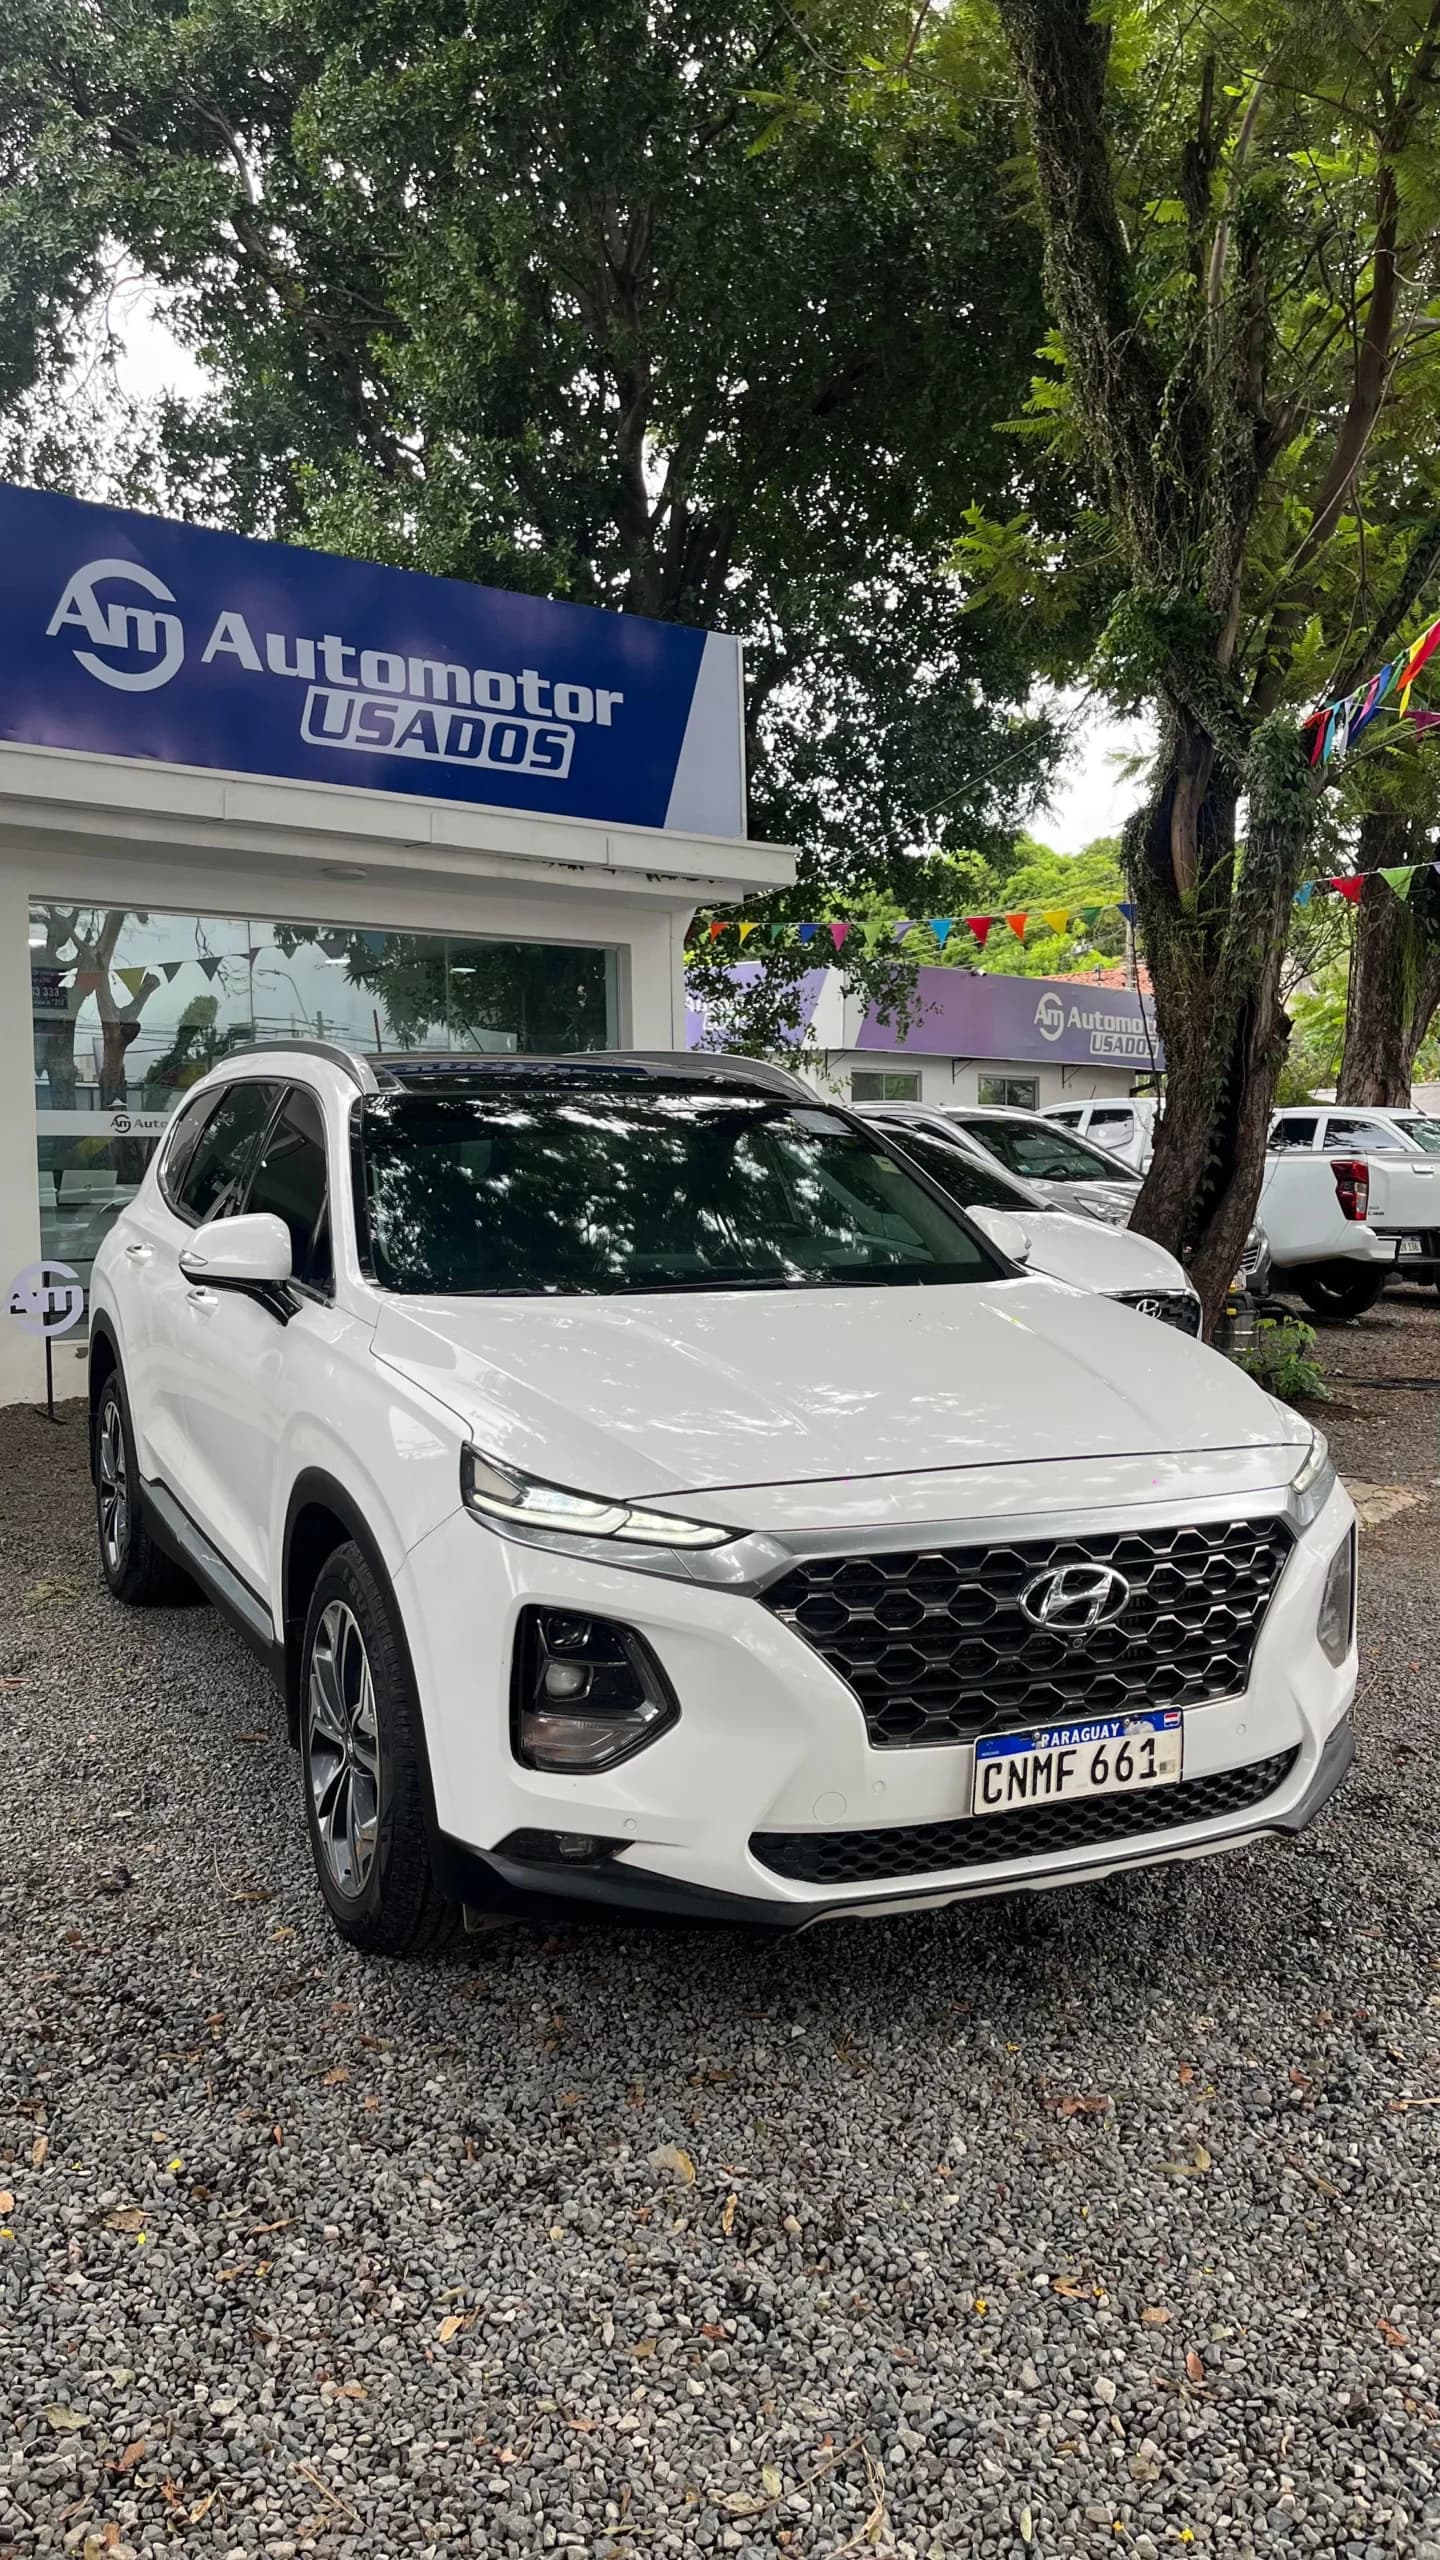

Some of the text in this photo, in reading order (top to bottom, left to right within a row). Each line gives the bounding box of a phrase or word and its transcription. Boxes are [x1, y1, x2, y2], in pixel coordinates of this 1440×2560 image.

[45, 559, 624, 727] Am Automotor
[308, 692, 569, 771] USADOS
[1034, 992, 1157, 1041] Am Automot
[1091, 1033, 1157, 1056] USADOS
[1041, 1722, 1120, 1748] PARAGUAY
[983, 1737, 1158, 1804] CNMF 661
